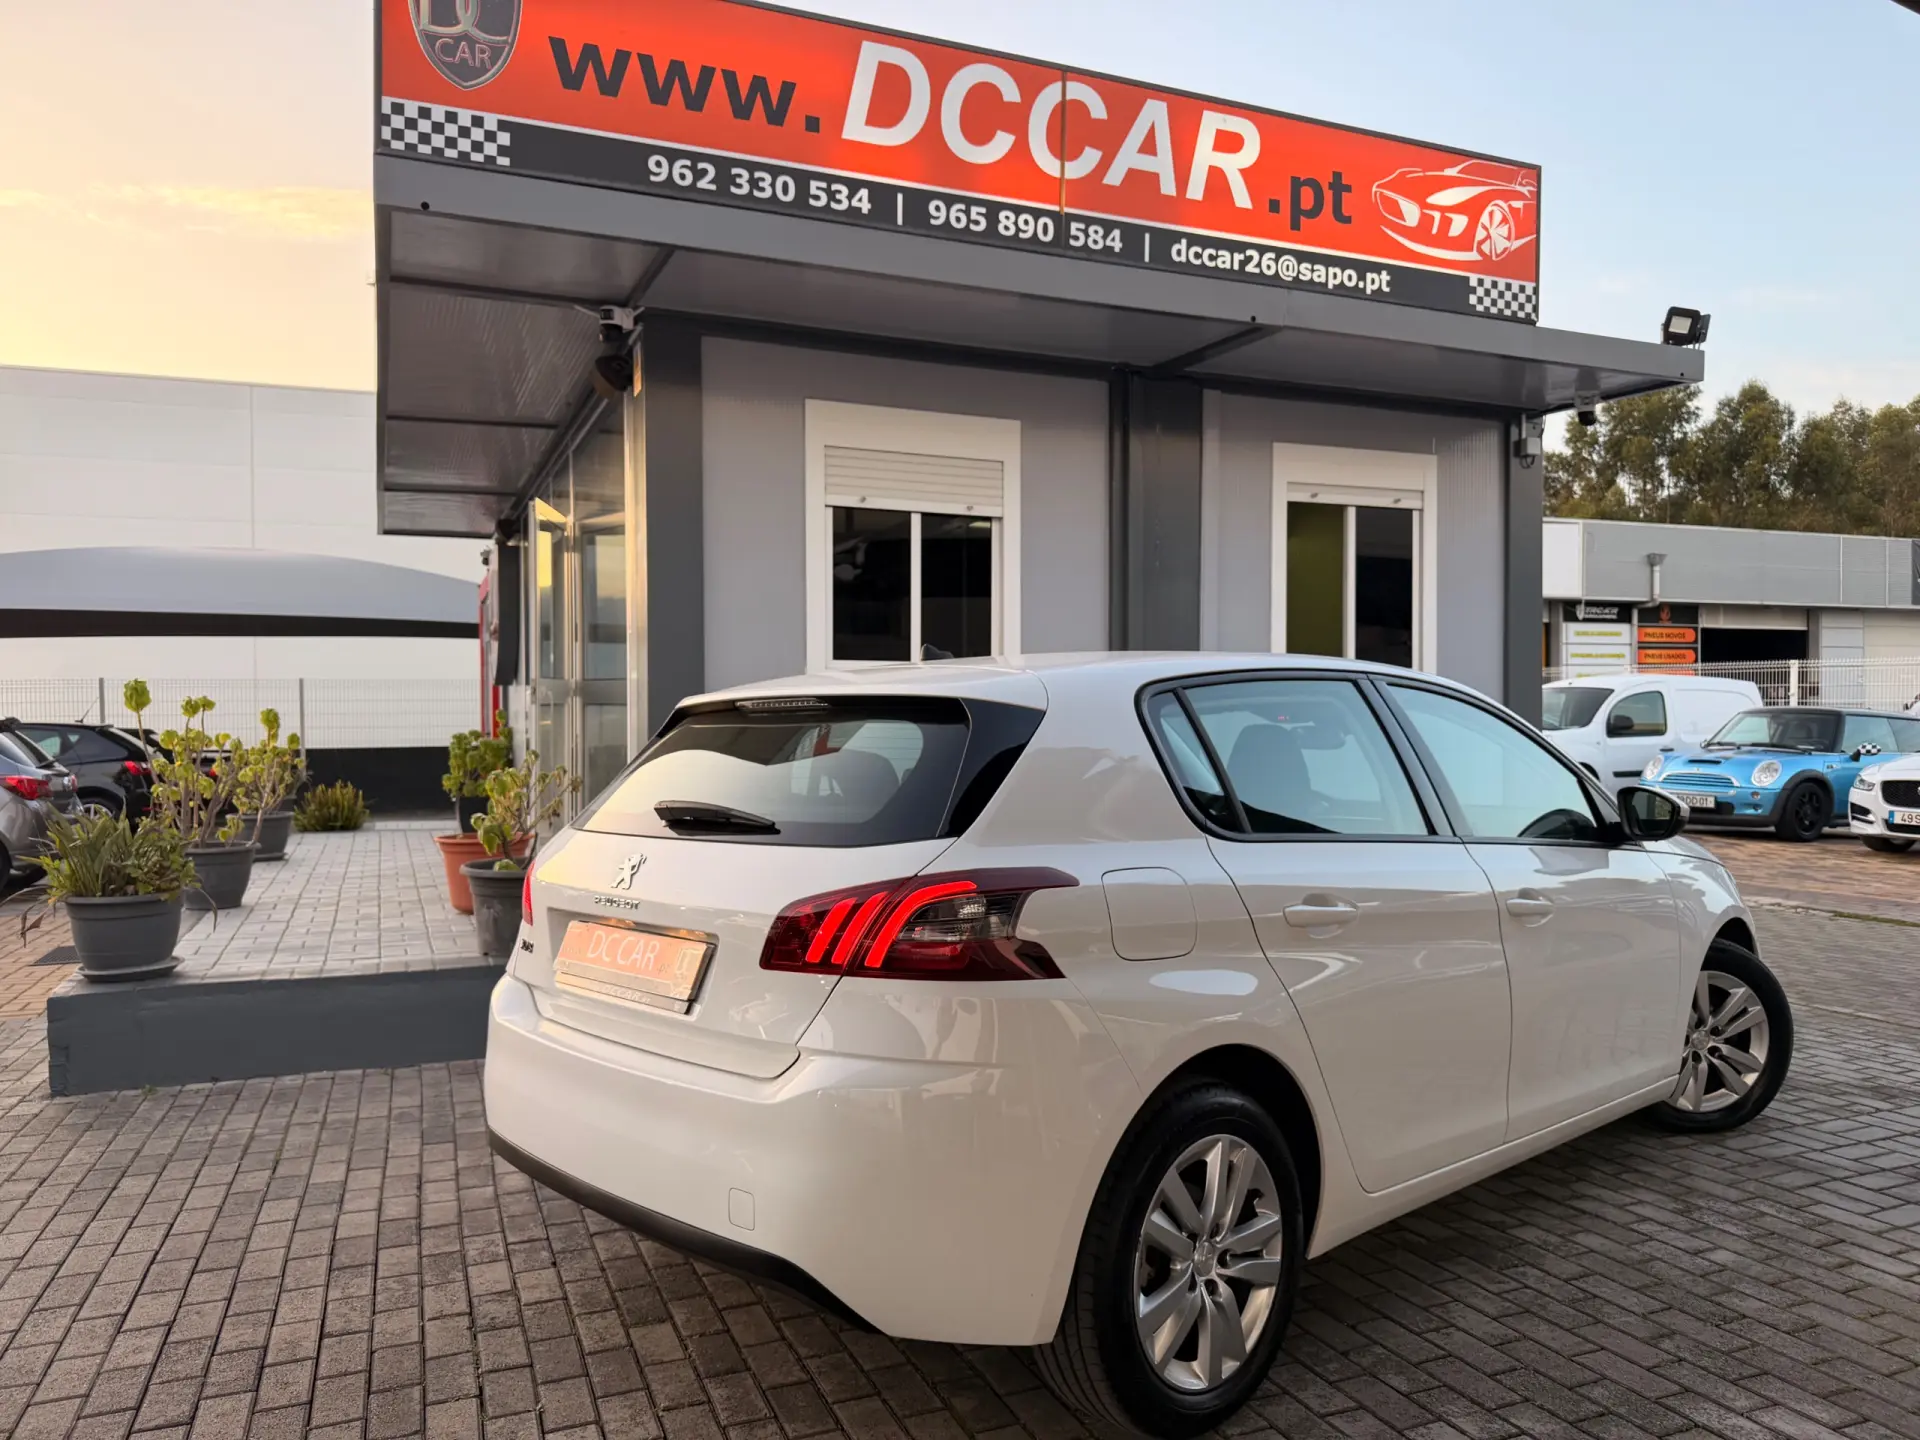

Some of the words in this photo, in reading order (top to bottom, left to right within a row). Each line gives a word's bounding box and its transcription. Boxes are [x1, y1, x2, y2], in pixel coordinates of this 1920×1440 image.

[434, 37, 493, 70] CAR
[647, 154, 717, 191] 962
[729, 166, 796, 203] 330
[808, 180, 872, 214] 534
[928, 199, 987, 233] 965
[997, 211, 1055, 243] 890
[1068, 221, 1123, 253] 584
[1170, 236, 1391, 294] dccar26@sapo.pt
[1664, 632, 1686, 640] NOVOS
[594, 895, 641, 910] PEUGEOT
